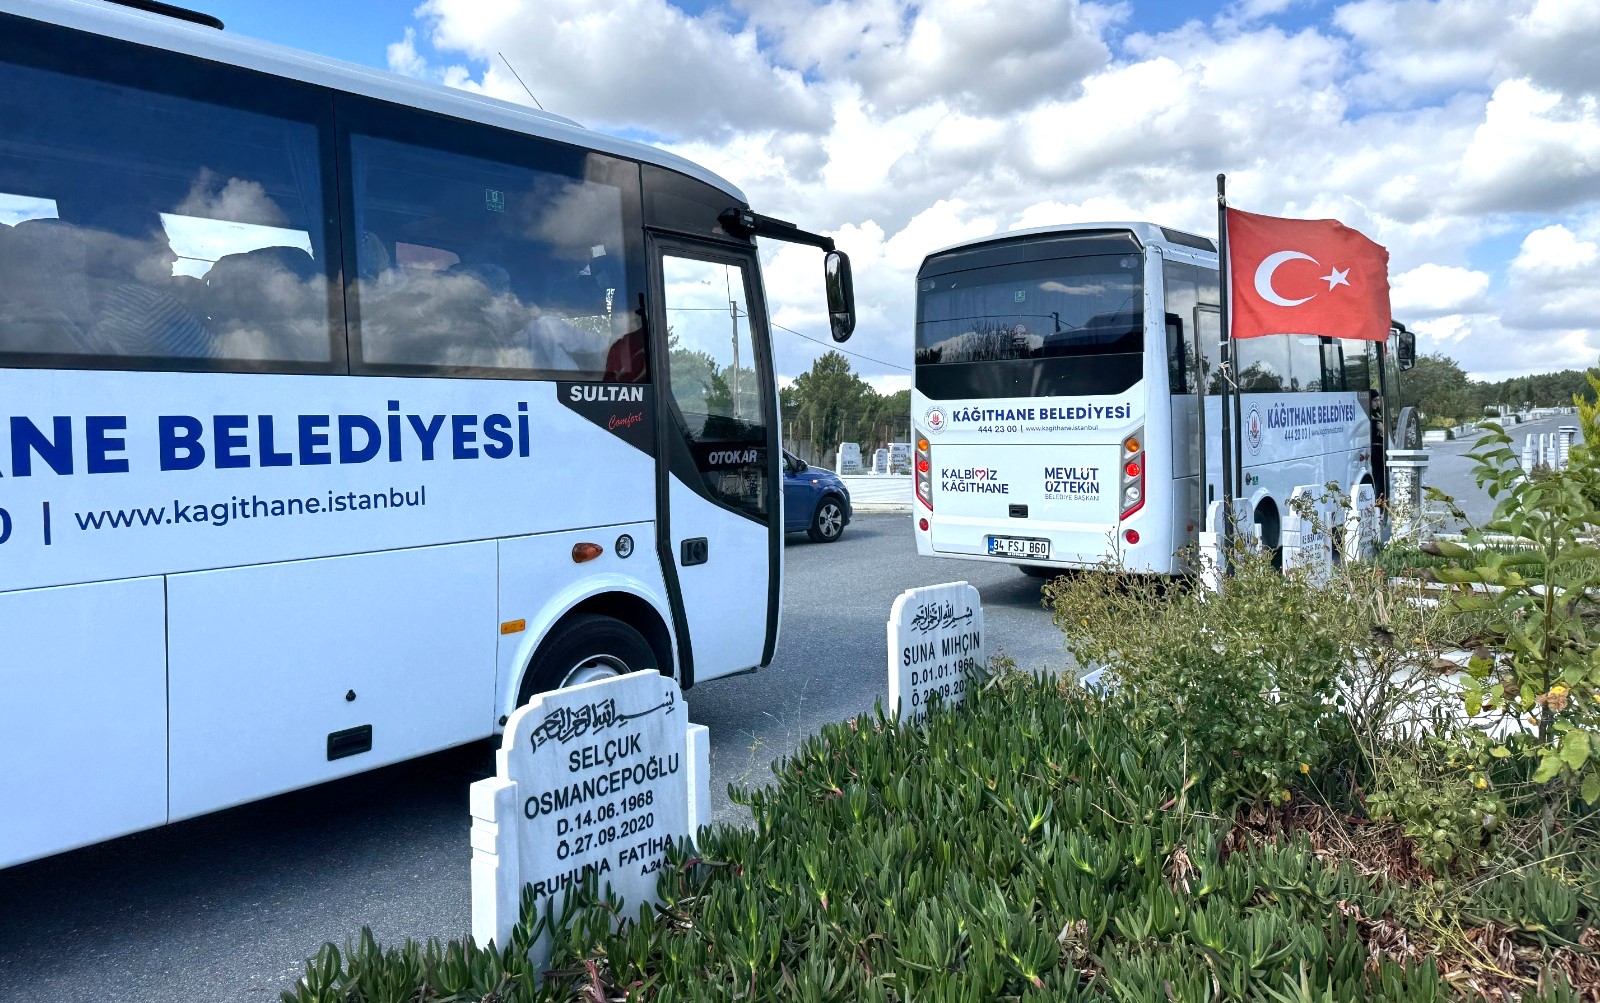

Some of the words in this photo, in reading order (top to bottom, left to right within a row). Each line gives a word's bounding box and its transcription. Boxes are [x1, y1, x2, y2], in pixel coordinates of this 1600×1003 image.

[570, 385, 644, 403] SULTAN
[608, 412, 643, 430] Comfort
[952, 406, 1036, 422] KÂĞITHANE
[1039, 402, 1132, 420] BELEDİYESİ
[1267, 403, 1316, 429] KÂĞITHANE
[1317, 400, 1356, 424] BELEDİYESİ
[0, 415, 130, 478] NE
[158, 400, 530, 472] BELEDİYESİ
[978, 425, 993, 433] 444
[995, 425, 1005, 433] 23
[1007, 425, 1018, 433] 00
[708, 450, 757, 465] OTOKAR
[1044, 466, 1099, 480] MEVLÜT
[941, 479, 1009, 495] KÂĞITHANE
[74, 485, 427, 532] www.kagithane.istanbul
[993, 539, 1004, 551] 34
[1008, 540, 1025, 552] FSJ
[1029, 542, 1046, 554] 860
[903, 641, 936, 667] SUNA
[941, 631, 980, 657] MIHÇIN
[568, 733, 642, 773] SELÇUK
[524, 752, 679, 820] OSMANCEPOĞLU
[556, 790, 654, 837] D.14.06.1968
[556, 812, 654, 861] Ö.27.09.2020
